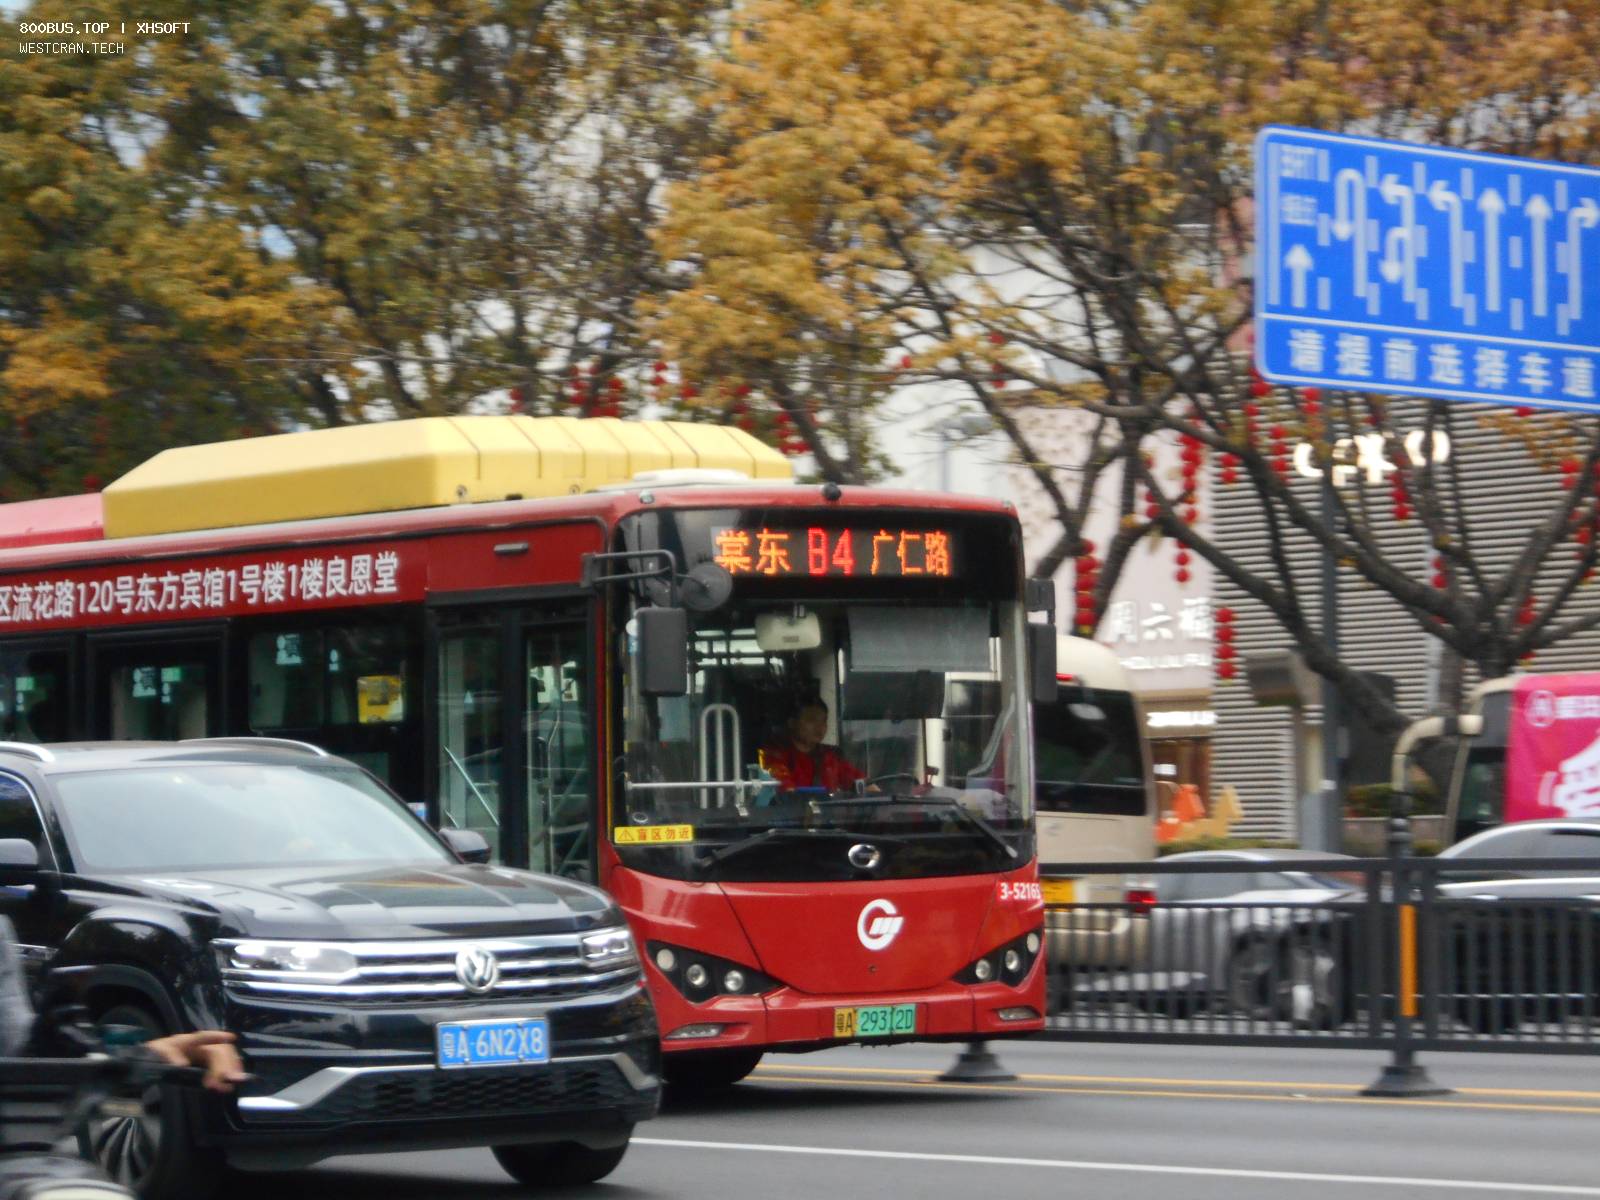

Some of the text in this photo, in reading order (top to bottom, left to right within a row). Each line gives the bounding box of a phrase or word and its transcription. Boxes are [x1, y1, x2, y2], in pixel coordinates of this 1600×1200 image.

[1288, 328, 1596, 398] 请提前选择车道
[714, 527, 949, 576] 棠东 B4 广仁路
